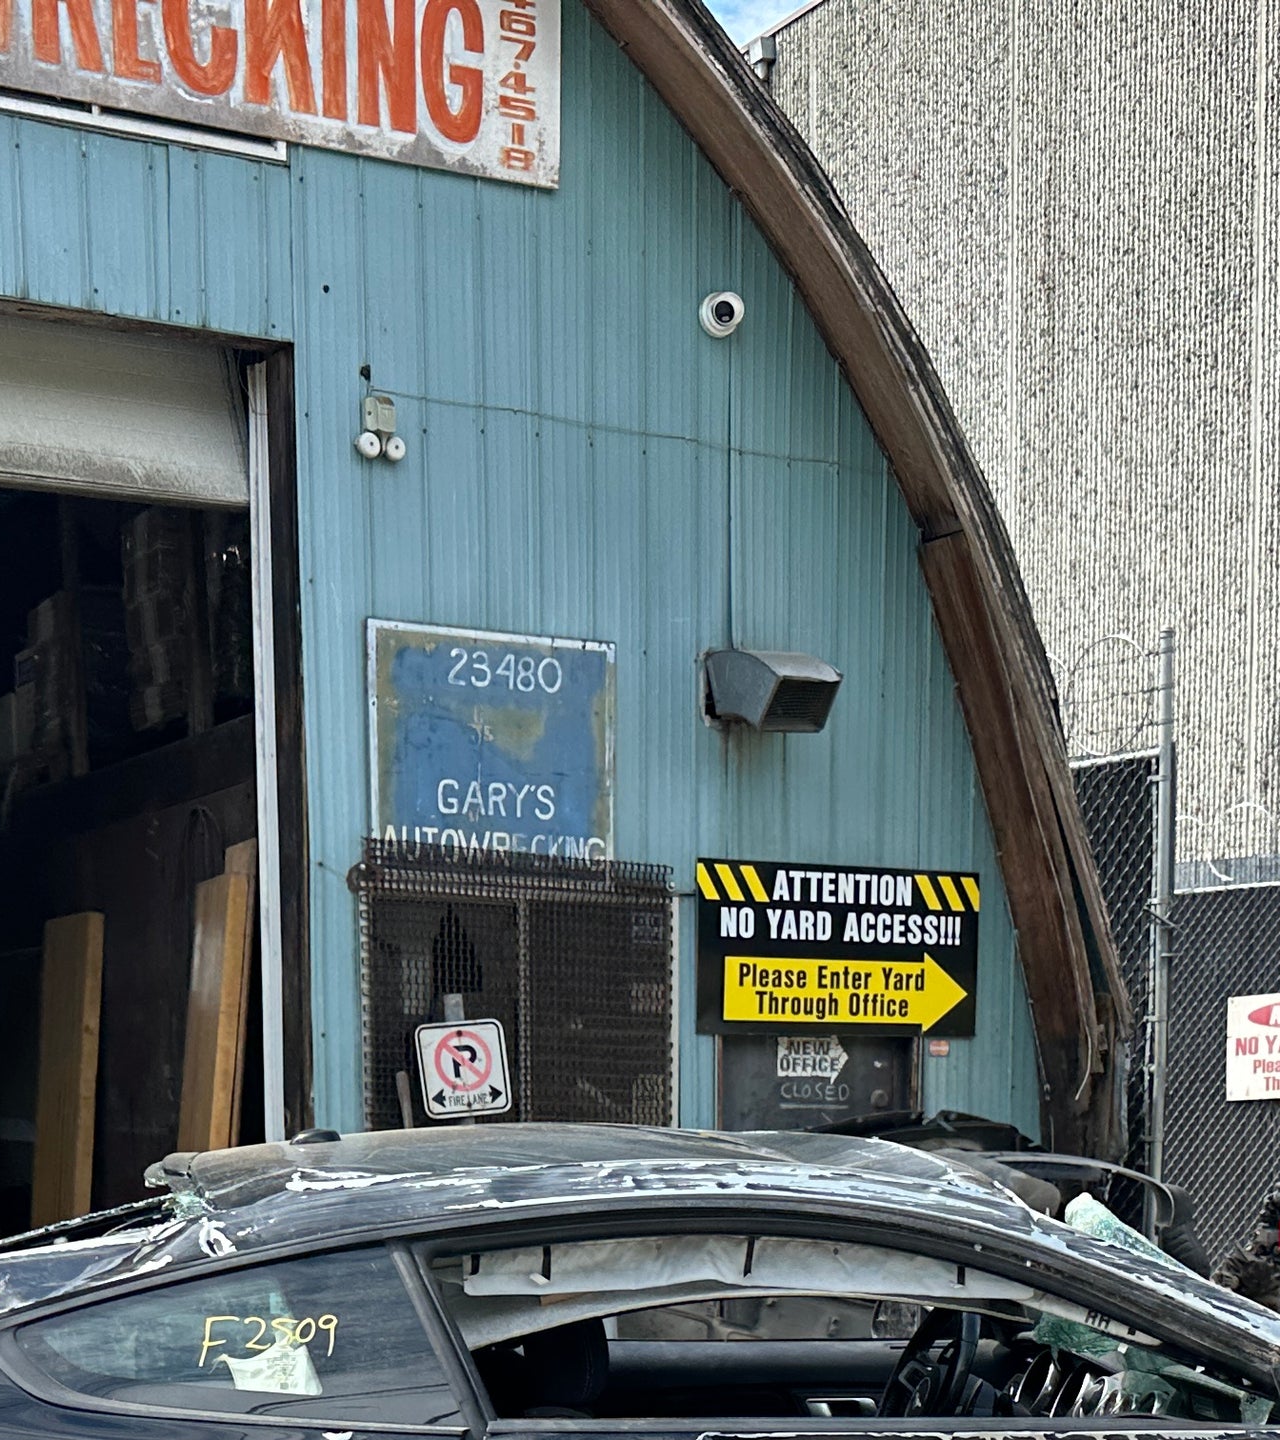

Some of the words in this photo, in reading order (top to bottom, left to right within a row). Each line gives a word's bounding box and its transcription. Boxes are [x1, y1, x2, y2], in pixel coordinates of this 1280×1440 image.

[447, 648, 562, 693] 23480
[437, 779, 555, 820] GARY'S
[772, 870, 912, 906] ATTENTION
[720, 907, 755, 938] NO
[766, 909, 832, 941] YARD
[843, 912, 961, 945] ACCESS!!!
[738, 963, 807, 988] Please
[818, 966, 872, 990] Enter
[882, 967, 925, 991] Yard
[755, 991, 838, 1019] Through
[849, 993, 909, 1017] Office
[788, 1039, 831, 1056] NEW
[1235, 1036, 1259, 1056] NO
[780, 1055, 841, 1073] OFFICE
[448, 1094, 466, 1107] FIRE
[780, 1082, 850, 1100] CLOSED
[198, 1314, 338, 1368] F2509
